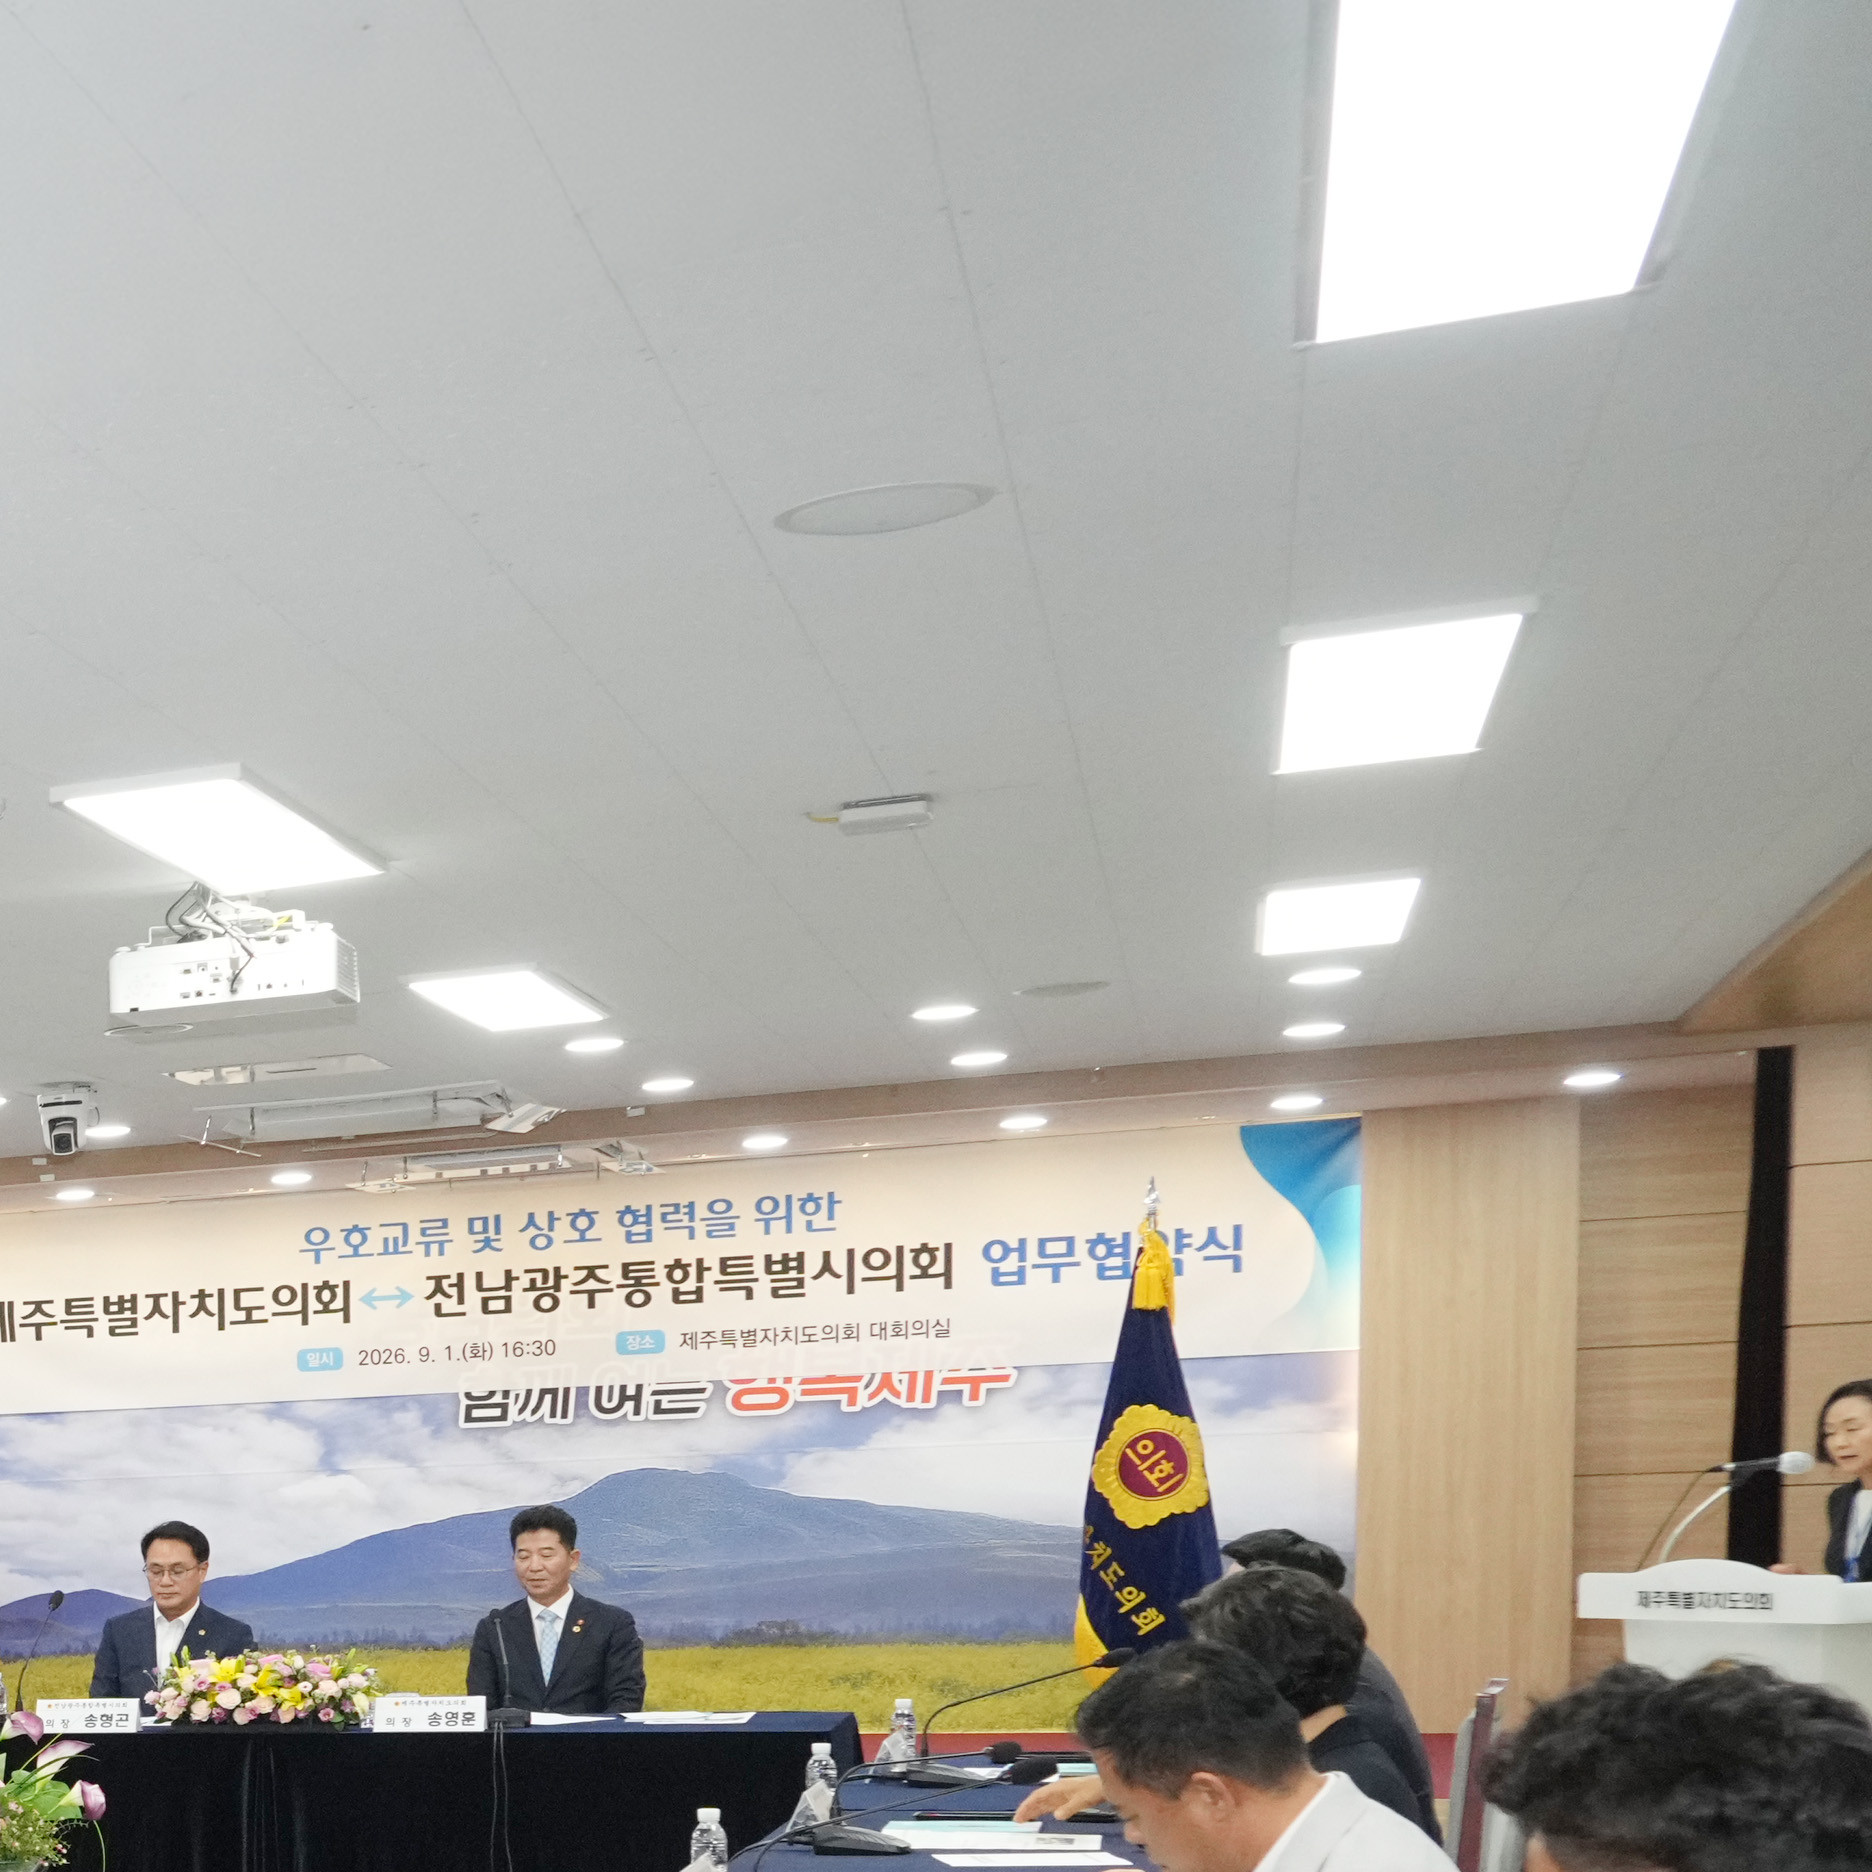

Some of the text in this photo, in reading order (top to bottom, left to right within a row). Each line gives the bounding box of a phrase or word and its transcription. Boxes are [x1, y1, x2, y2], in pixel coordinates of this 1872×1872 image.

[299, 1191, 843, 1264] 우호교류 및 상호 협력을 위한
[424, 1242, 953, 1318] 전남광주통합특별시의회
[626, 1334, 656, 1350] 장소
[679, 1318, 951, 1350] 제주특별자치도의회 대회의실
[307, 1351, 334, 1367] 일시
[358, 1348, 411, 1366] 2026.
[418, 1346, 436, 1362] 9.
[502, 1339, 556, 1358] 16:30
[1125, 1439, 1184, 1492] 의회
[1636, 1590, 1774, 1610] 제주특별자치도의회
[85, 1713, 129, 1728] 송형곤
[428, 1711, 475, 1727] 송영훈
